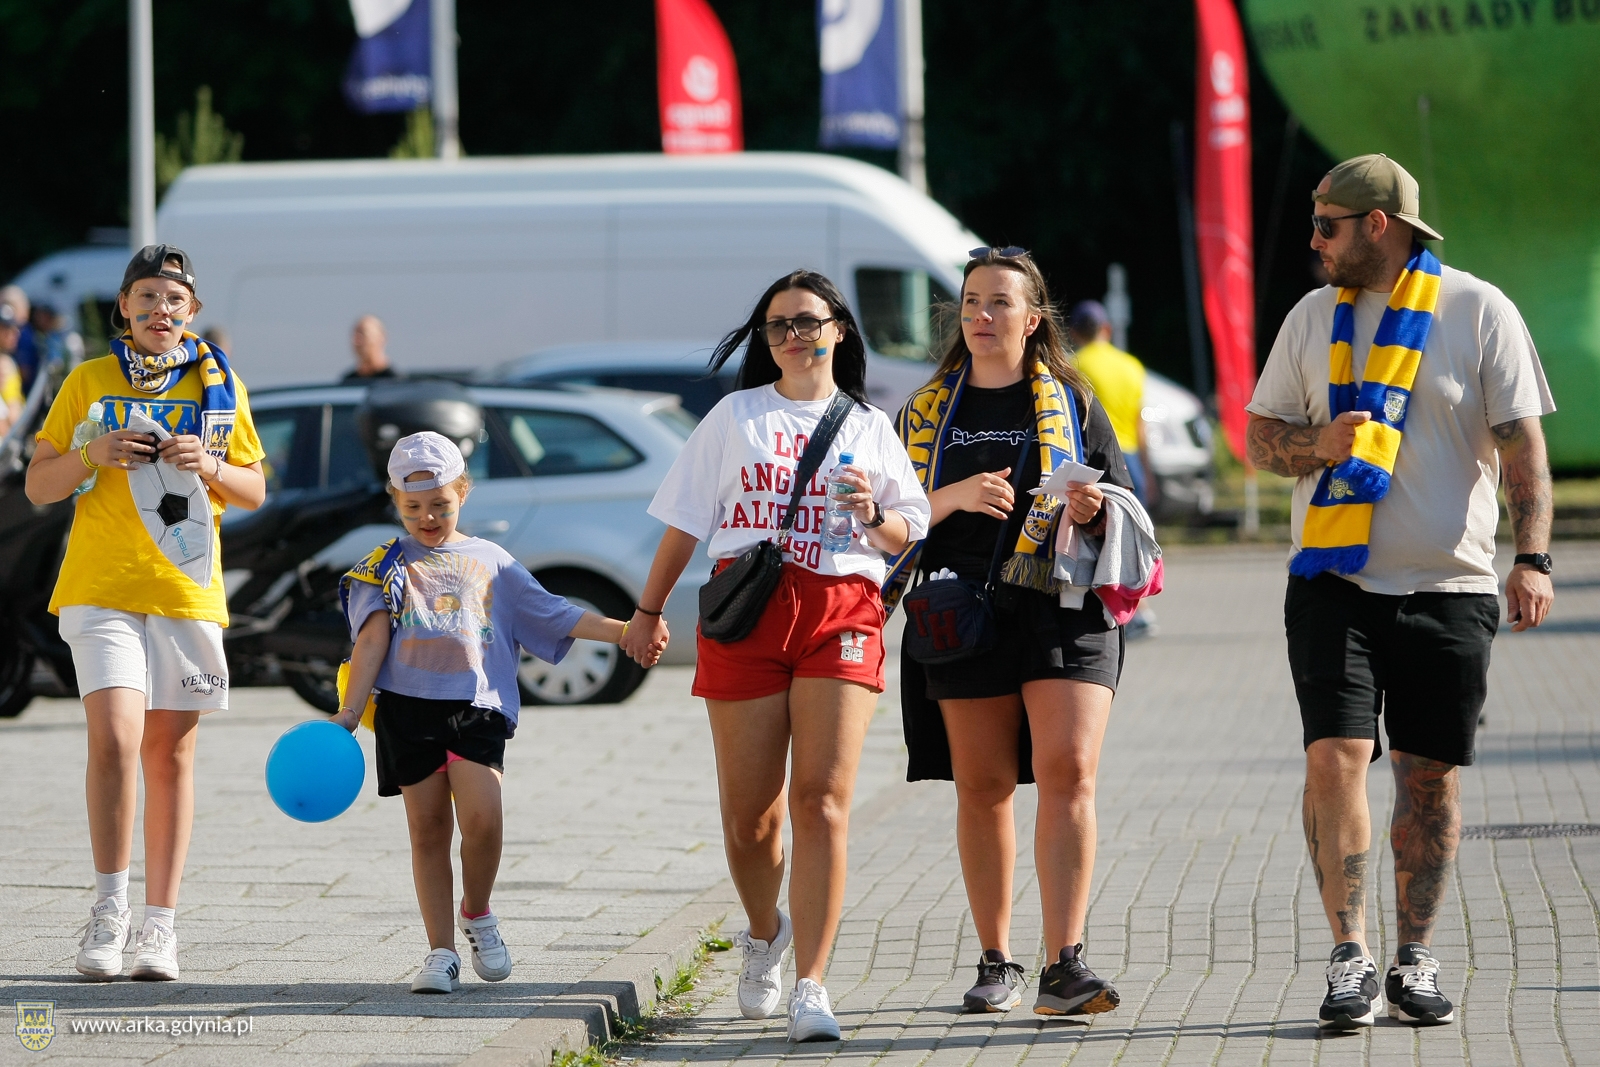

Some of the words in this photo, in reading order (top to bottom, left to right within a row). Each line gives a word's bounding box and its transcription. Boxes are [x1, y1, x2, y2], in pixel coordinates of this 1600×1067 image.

[774, 432, 808, 462] LO
[944, 427, 1040, 450] Champ
[1029, 510, 1054, 521] ARK
[841, 646, 864, 663] 82
[181, 674, 227, 691] VENICE
[1410, 947, 1430, 955] LACOSTE
